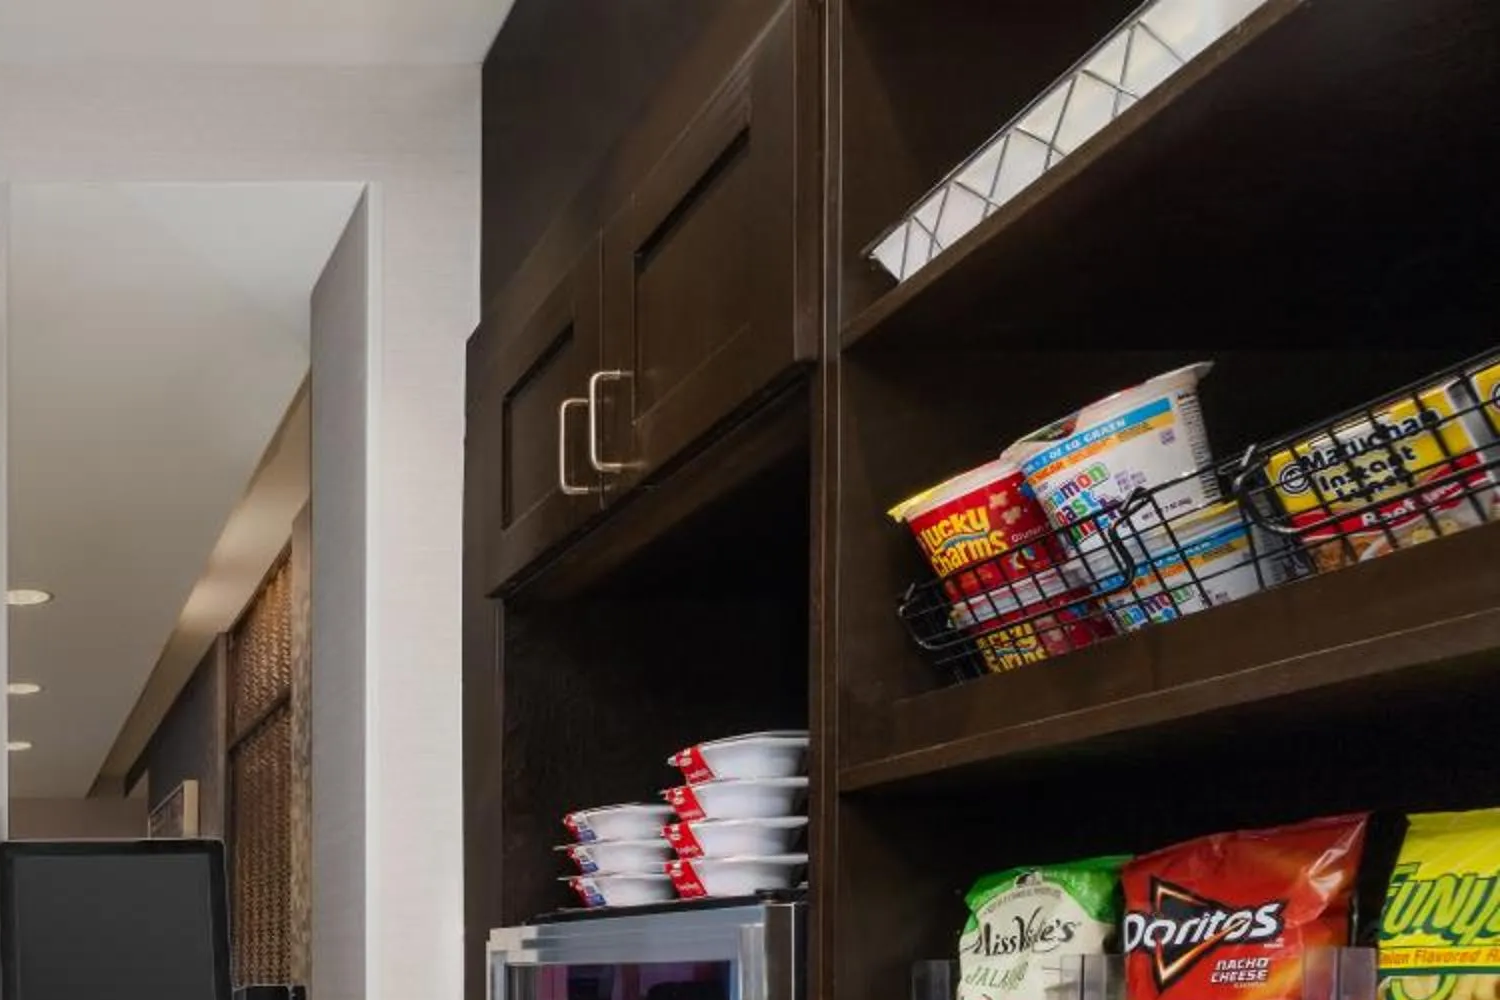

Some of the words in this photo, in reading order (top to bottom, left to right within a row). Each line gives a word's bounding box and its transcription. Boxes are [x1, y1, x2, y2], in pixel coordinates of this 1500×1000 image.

[1124, 902, 1282, 954] Doritos
[1216, 957, 1269, 971] NACHO
[1210, 969, 1268, 984] CHEESE
